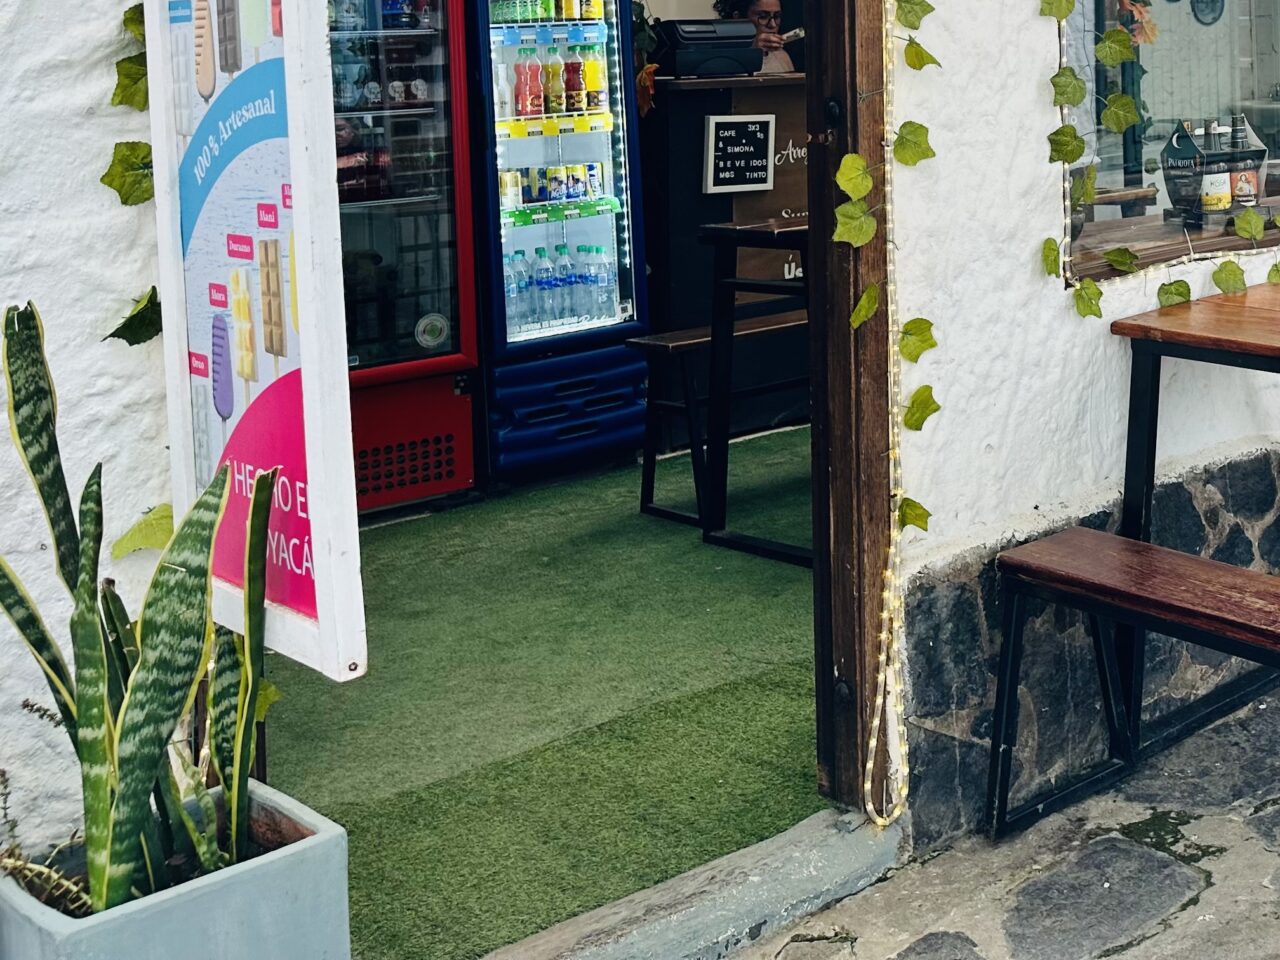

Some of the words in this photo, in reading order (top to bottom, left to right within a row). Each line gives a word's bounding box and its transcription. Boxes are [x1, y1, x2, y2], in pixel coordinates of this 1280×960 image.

[218, 89, 276, 147] Artesanal
[727, 145, 754, 153] SIMONA
[233, 460, 293, 512] HEO
[296, 480, 310, 519] E
